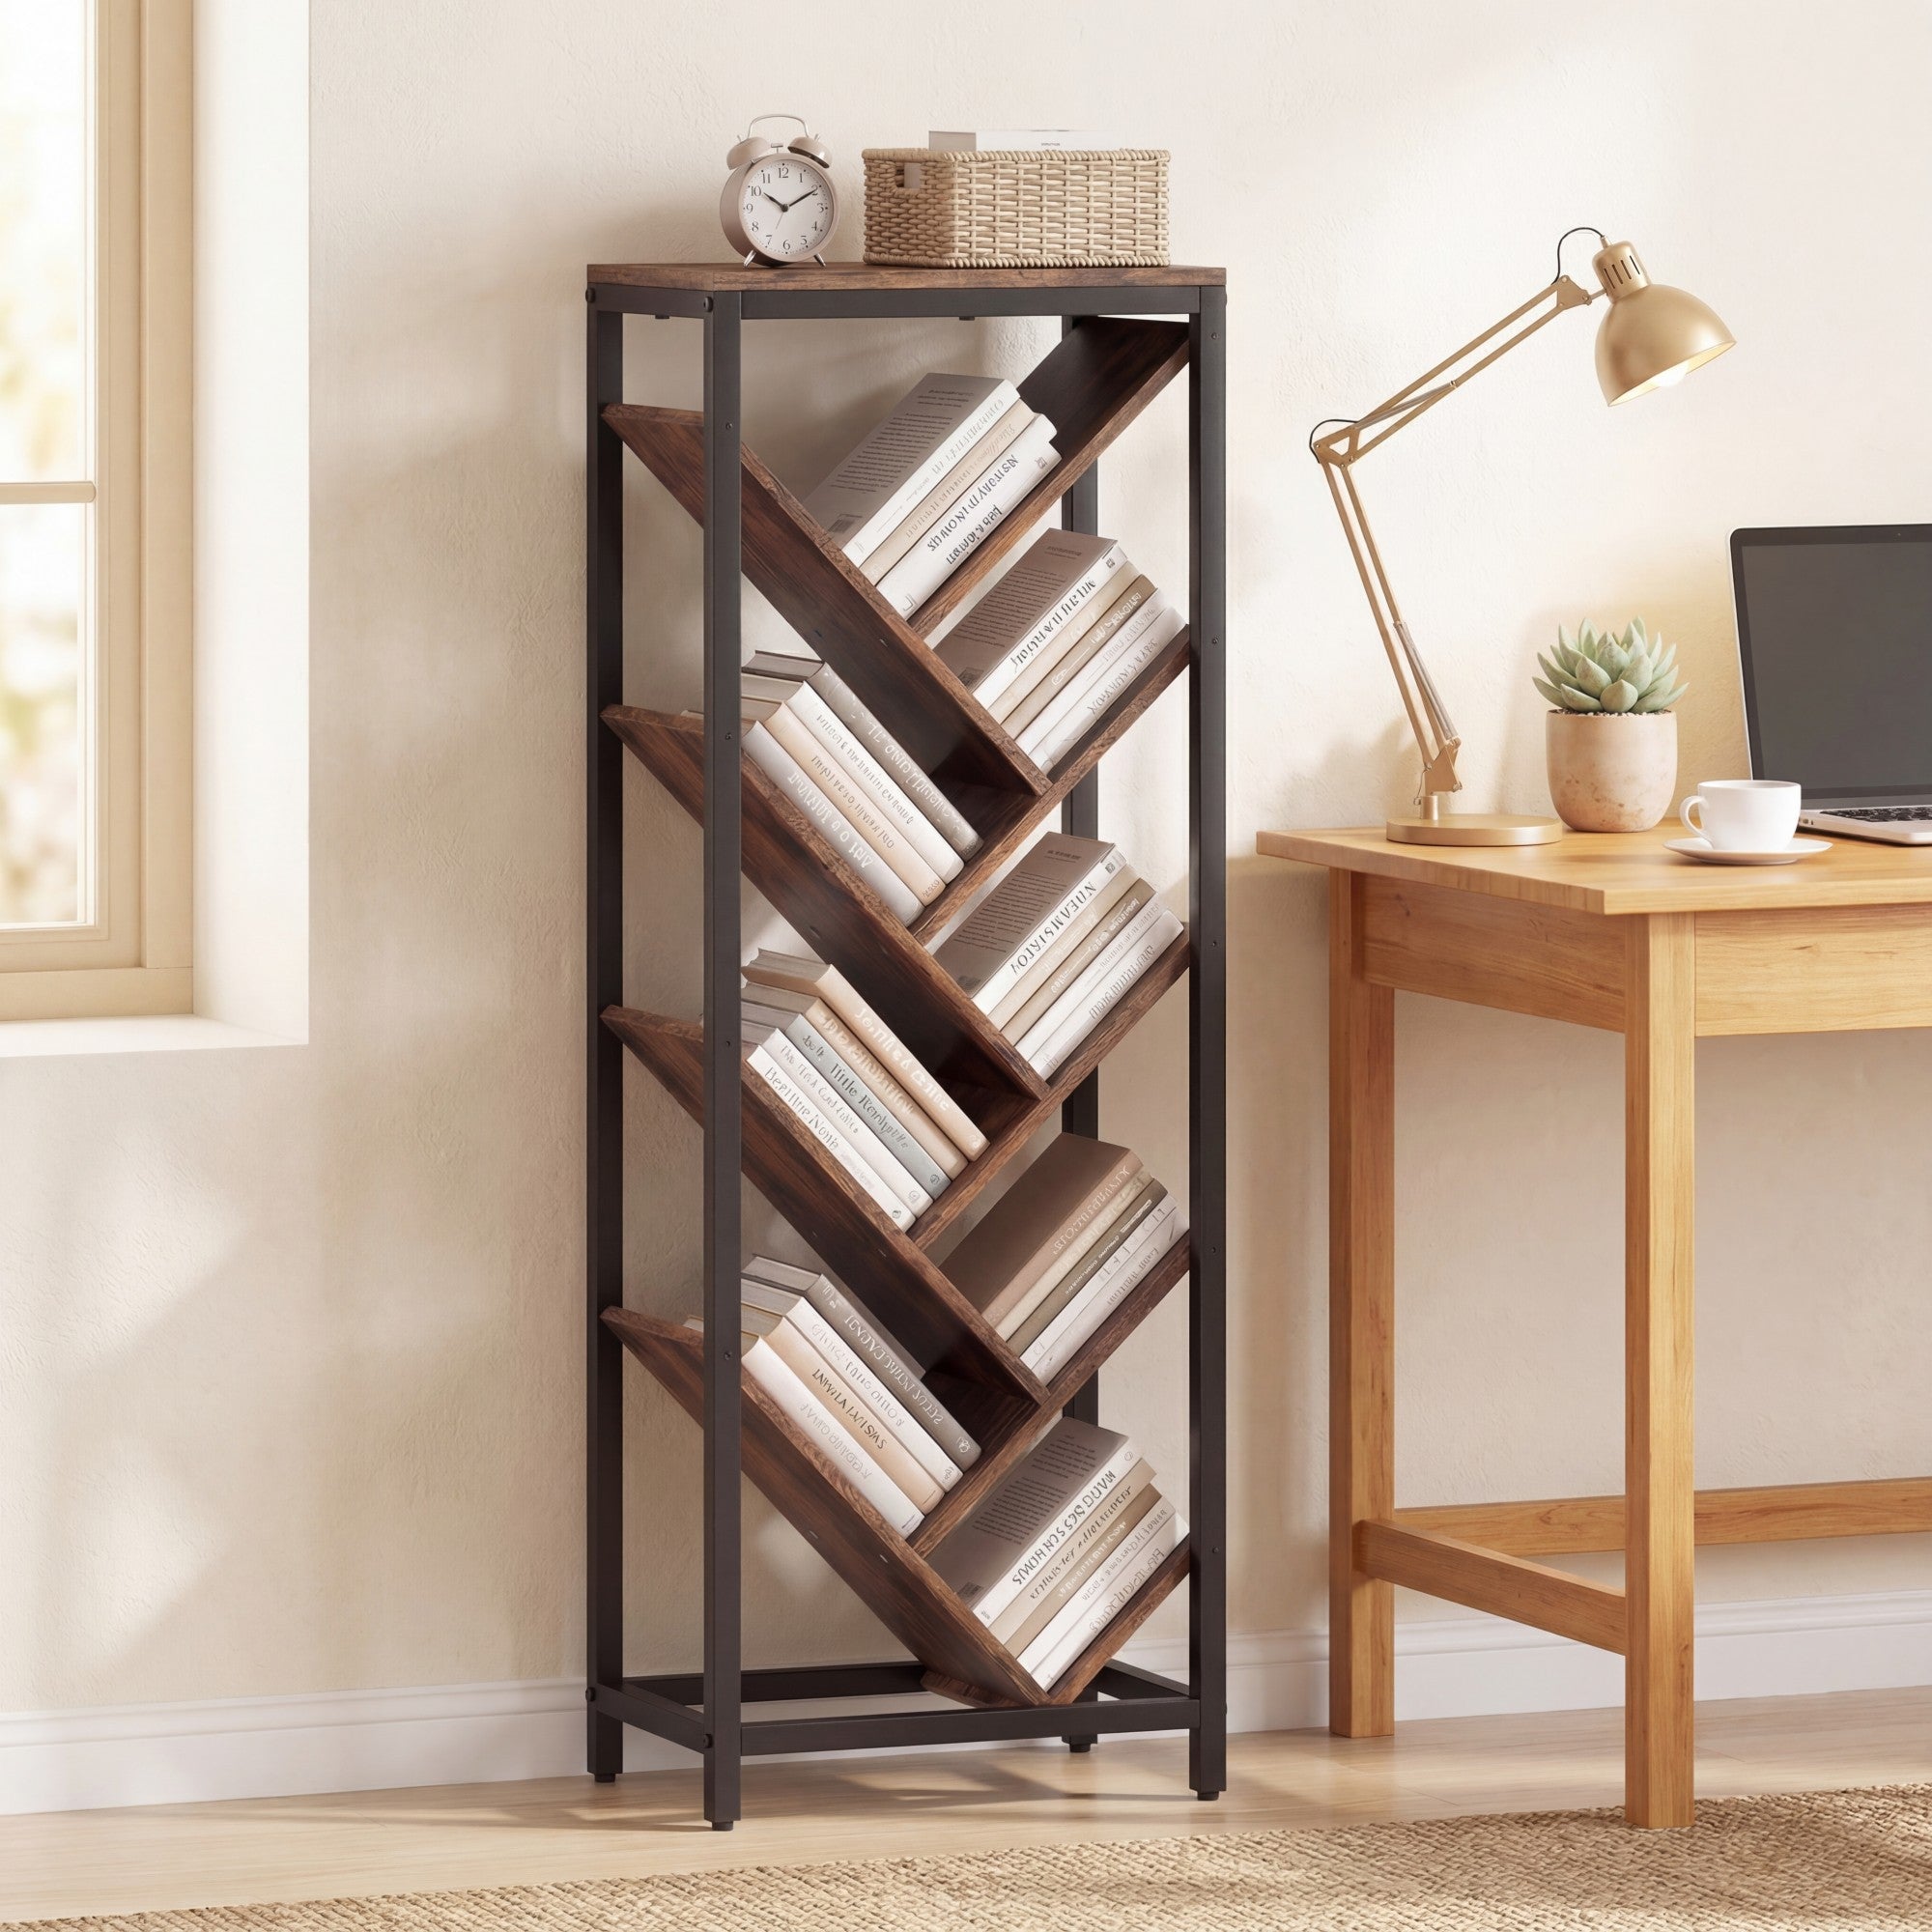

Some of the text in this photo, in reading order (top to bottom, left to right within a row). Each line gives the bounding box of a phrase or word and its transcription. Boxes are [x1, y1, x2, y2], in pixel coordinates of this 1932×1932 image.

[778, 167, 788, 178] 12
[762, 173, 770, 184] 11
[751, 185, 761, 196] 10
[746, 203, 753, 213] 9
[816, 202, 824, 213] 3
[752, 220, 758, 231] 8
[810, 220, 817, 231] 4
[765, 234, 772, 244] 7
[782, 239, 790, 249] 6
